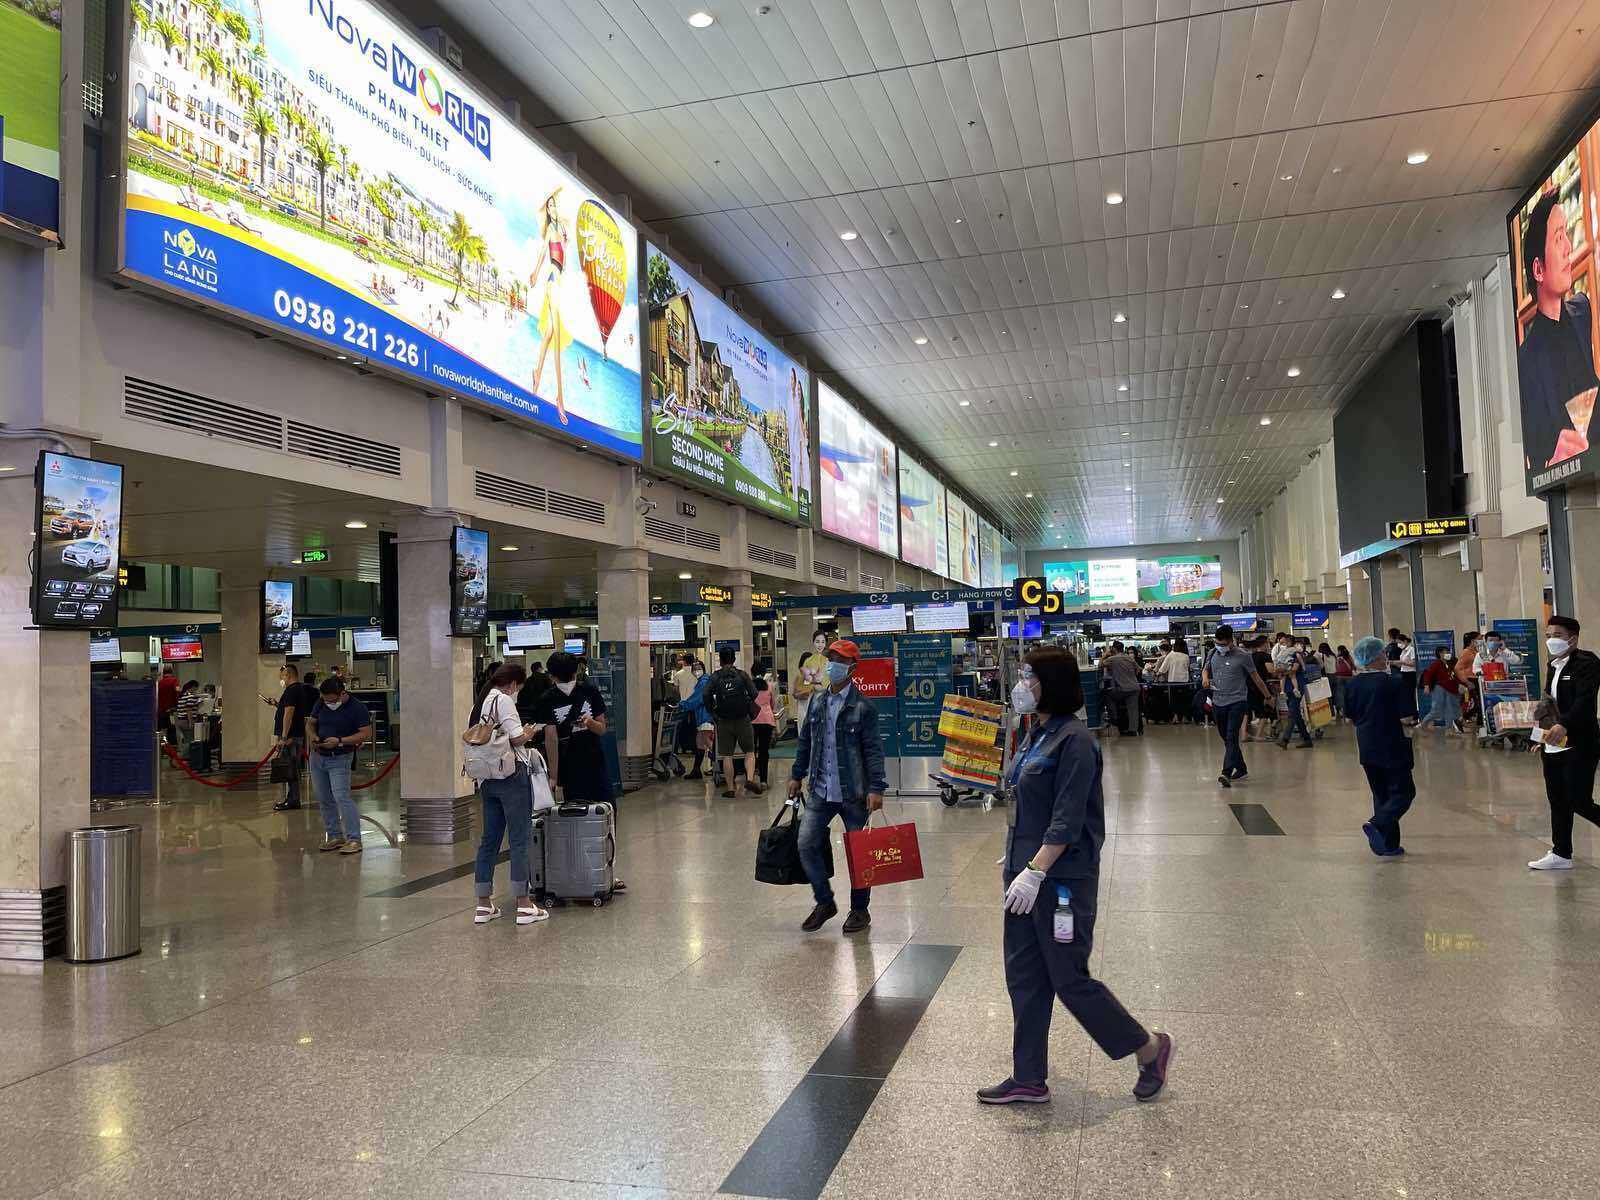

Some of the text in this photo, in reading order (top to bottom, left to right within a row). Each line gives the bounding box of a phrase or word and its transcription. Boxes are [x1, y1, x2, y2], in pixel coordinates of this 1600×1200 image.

[368, 82, 407, 121] PHAN
[164, 229, 217, 264] NOVA
[164, 253, 218, 285] LAND
[273, 290, 539, 414] 0938 221 226 novaworldphanthiet.com.vn
[672, 435, 724, 471] SECOND HOME
[870, 594, 889, 603] C-2
[931, 591, 949, 600] C-1
[1004, 588, 1013, 597] C
[1022, 580, 1041, 604] C
[651, 604, 668, 614] C-3
[1044, 594, 1059, 613] D
[186, 624, 200, 634] C-7
[904, 679, 935, 699] 40
[907, 720, 934, 741] 15
